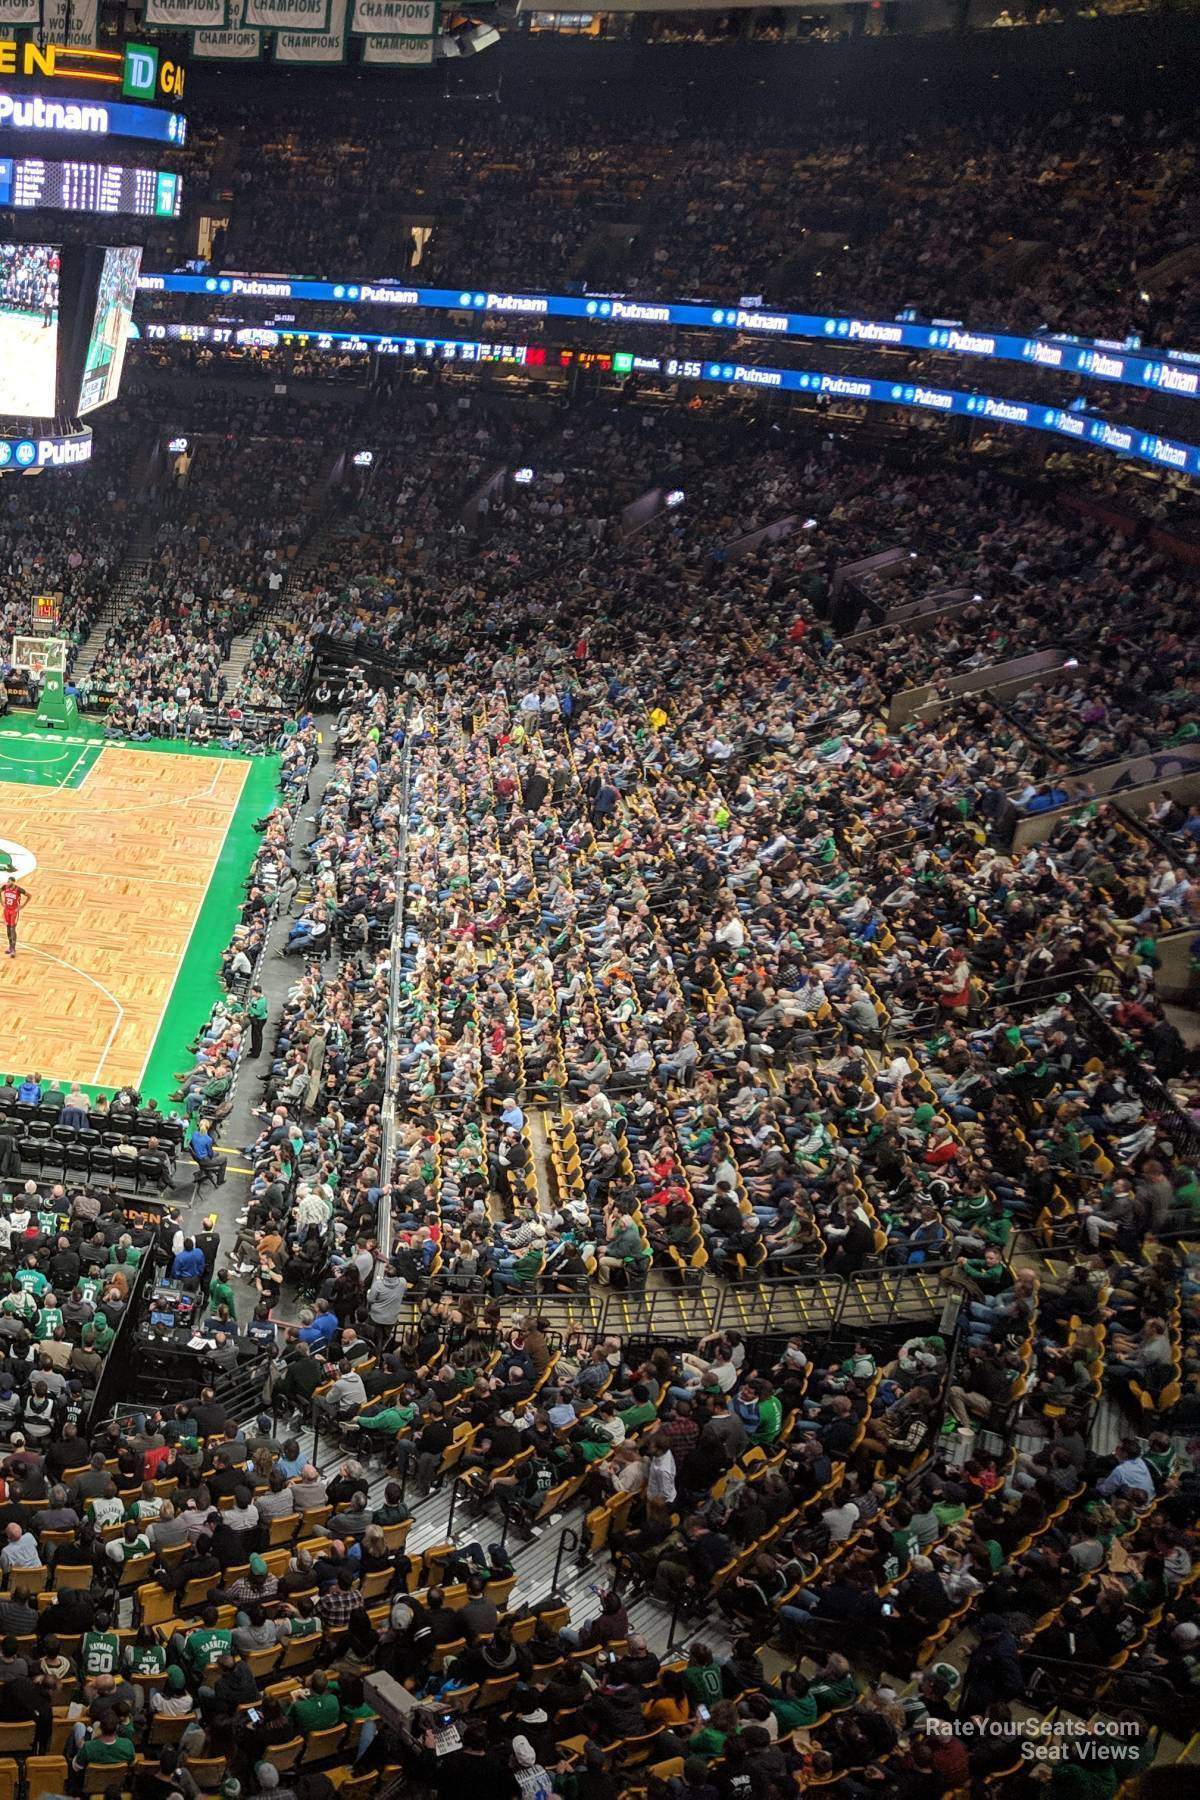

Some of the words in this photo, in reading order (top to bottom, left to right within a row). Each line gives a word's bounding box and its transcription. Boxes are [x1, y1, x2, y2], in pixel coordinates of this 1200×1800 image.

[358, 2, 430, 19] CHAMPIONS
[199, 30, 256, 46] CHAMPIONS
[281, 34, 340, 50] CHAMPIONS
[369, 35, 429, 51] CHAMPIONS
[126, 53, 155, 85] TD
[232, 279, 291, 297] Putnam
[361, 286, 419, 304] Putnam
[487, 294, 548, 312] Putnam
[611, 302, 671, 322] Putnam
[736, 311, 789, 331] Putnam
[147, 324, 166, 339] 70
[213, 328, 233, 342] 57
[849, 319, 903, 342] Putnam
[947, 331, 995, 355] Putnam
[634, 358, 660, 370] Bank
[666, 360, 702, 377] 8:55
[734, 366, 782, 386] Putnam
[1158, 365, 1199, 394] Putnam
[821, 377, 872, 396] Putnam
[913, 388, 953, 409] Putnam
[984, 400, 1029, 422] Putnam
[1153, 439, 1188, 467] Putnam
[0, 730, 127, 748] GARDEN
[88, 1640, 115, 1652] HAYWARD
[201, 1639, 229, 1653] GARNETT
[87, 1652, 113, 1673] 20
[702, 1670, 720, 1695] 0
